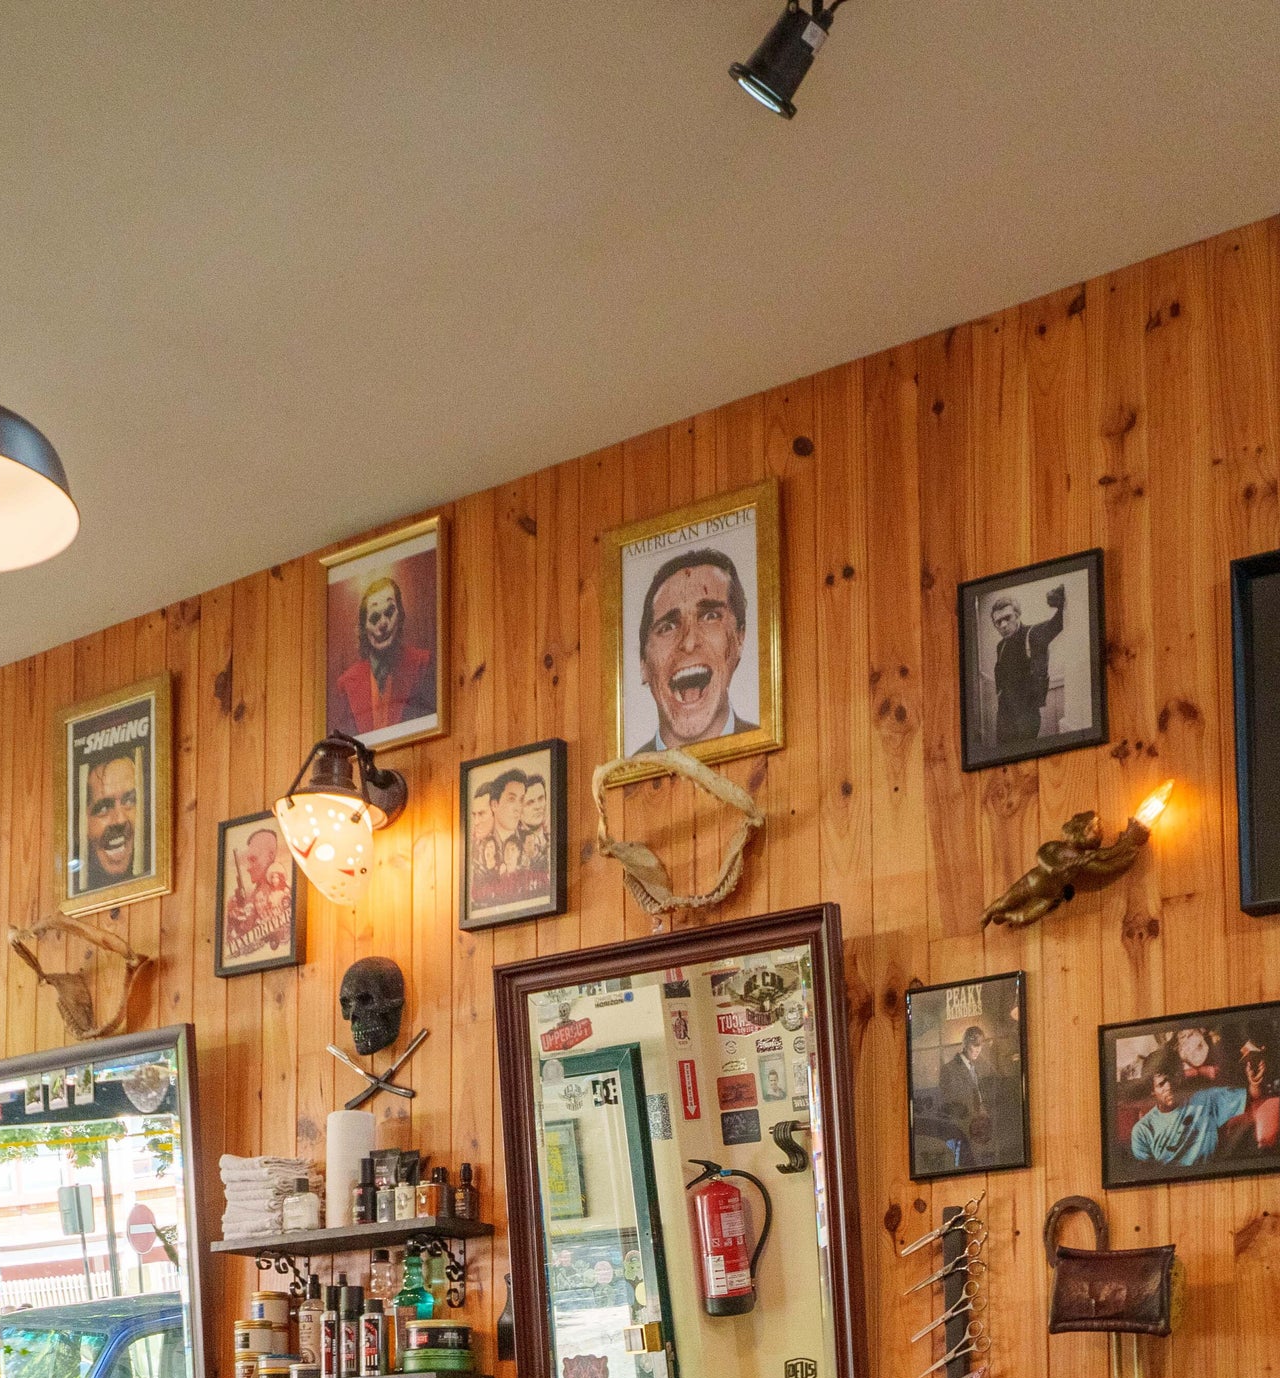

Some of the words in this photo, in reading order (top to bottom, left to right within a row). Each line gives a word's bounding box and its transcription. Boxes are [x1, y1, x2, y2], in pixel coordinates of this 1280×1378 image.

[625, 525, 698, 557] AMERICAN
[74, 736, 86, 747] THE
[84, 716, 150, 754] SHINING
[946, 984, 983, 1006] PEAKY
